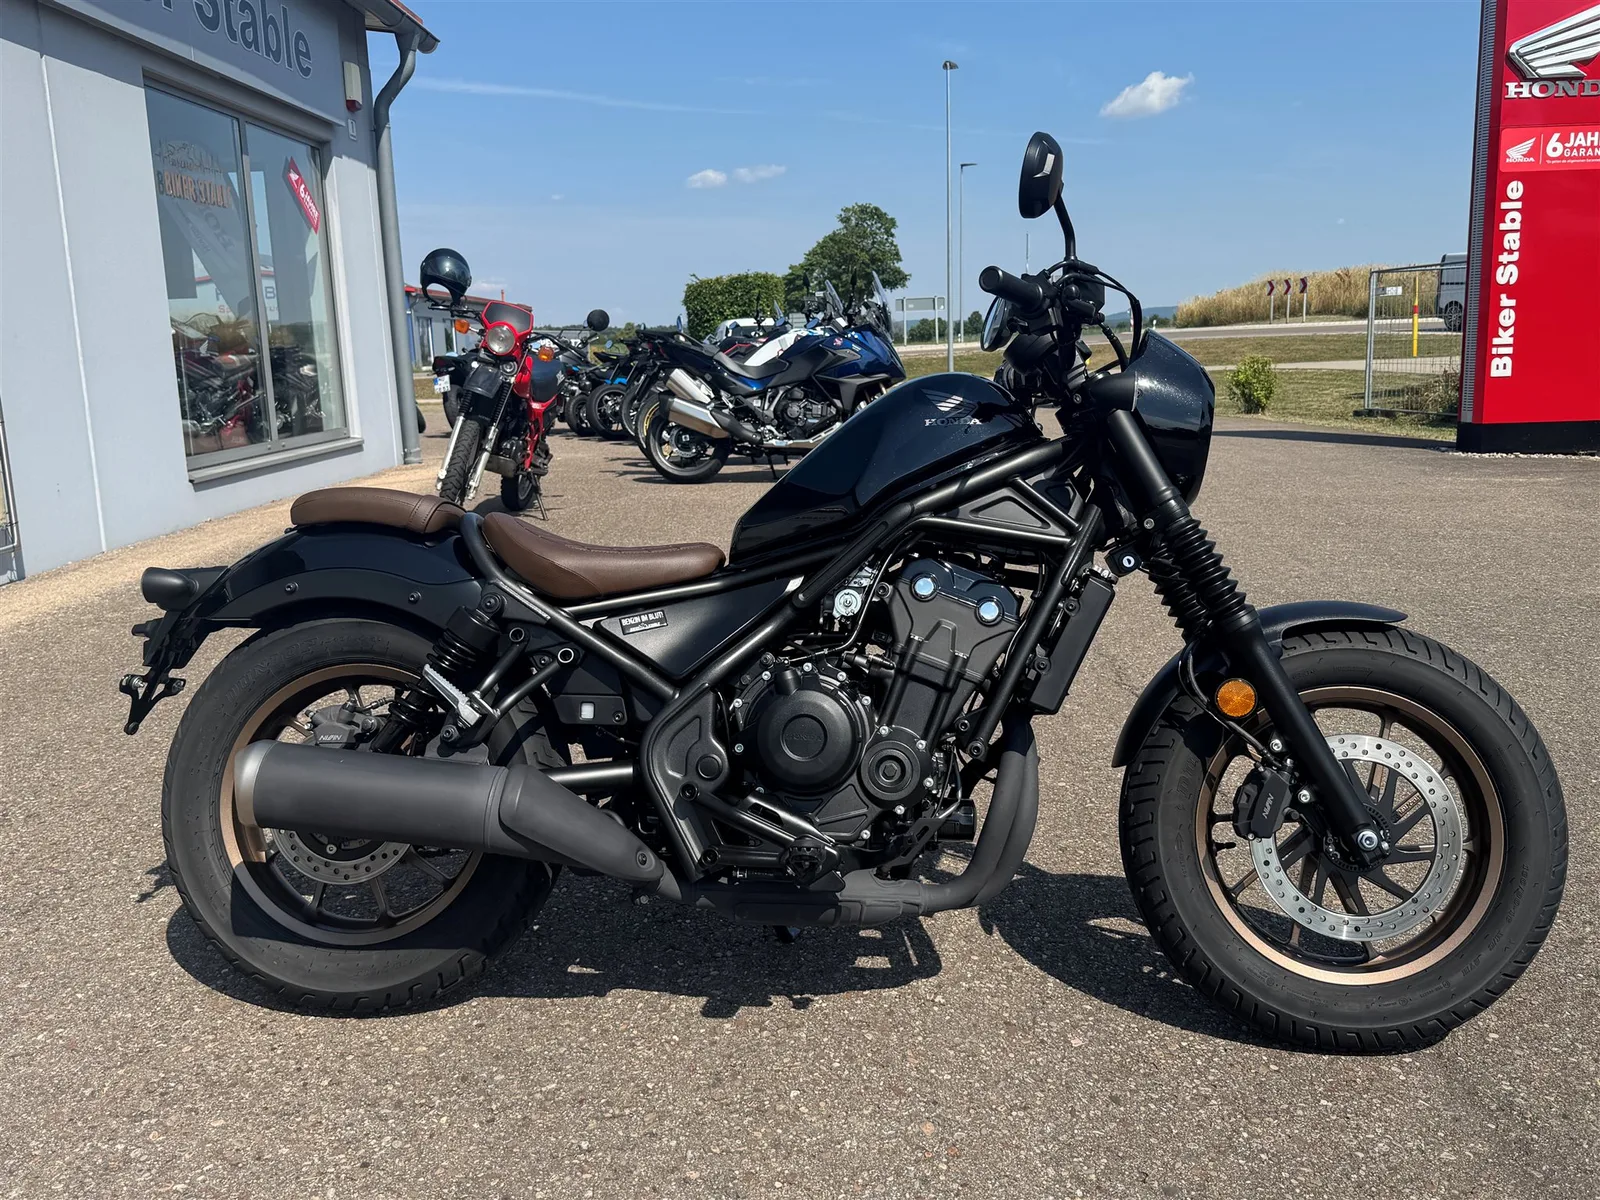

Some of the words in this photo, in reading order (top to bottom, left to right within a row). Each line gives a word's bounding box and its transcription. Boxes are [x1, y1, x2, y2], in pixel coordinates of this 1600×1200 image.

[1546, 132, 1564, 157] 6
[1564, 131, 1600, 148] JAH
[1496, 180, 1524, 285] Stable
[1490, 293, 1516, 378] Biker
[924, 416, 982, 427] HONDA
